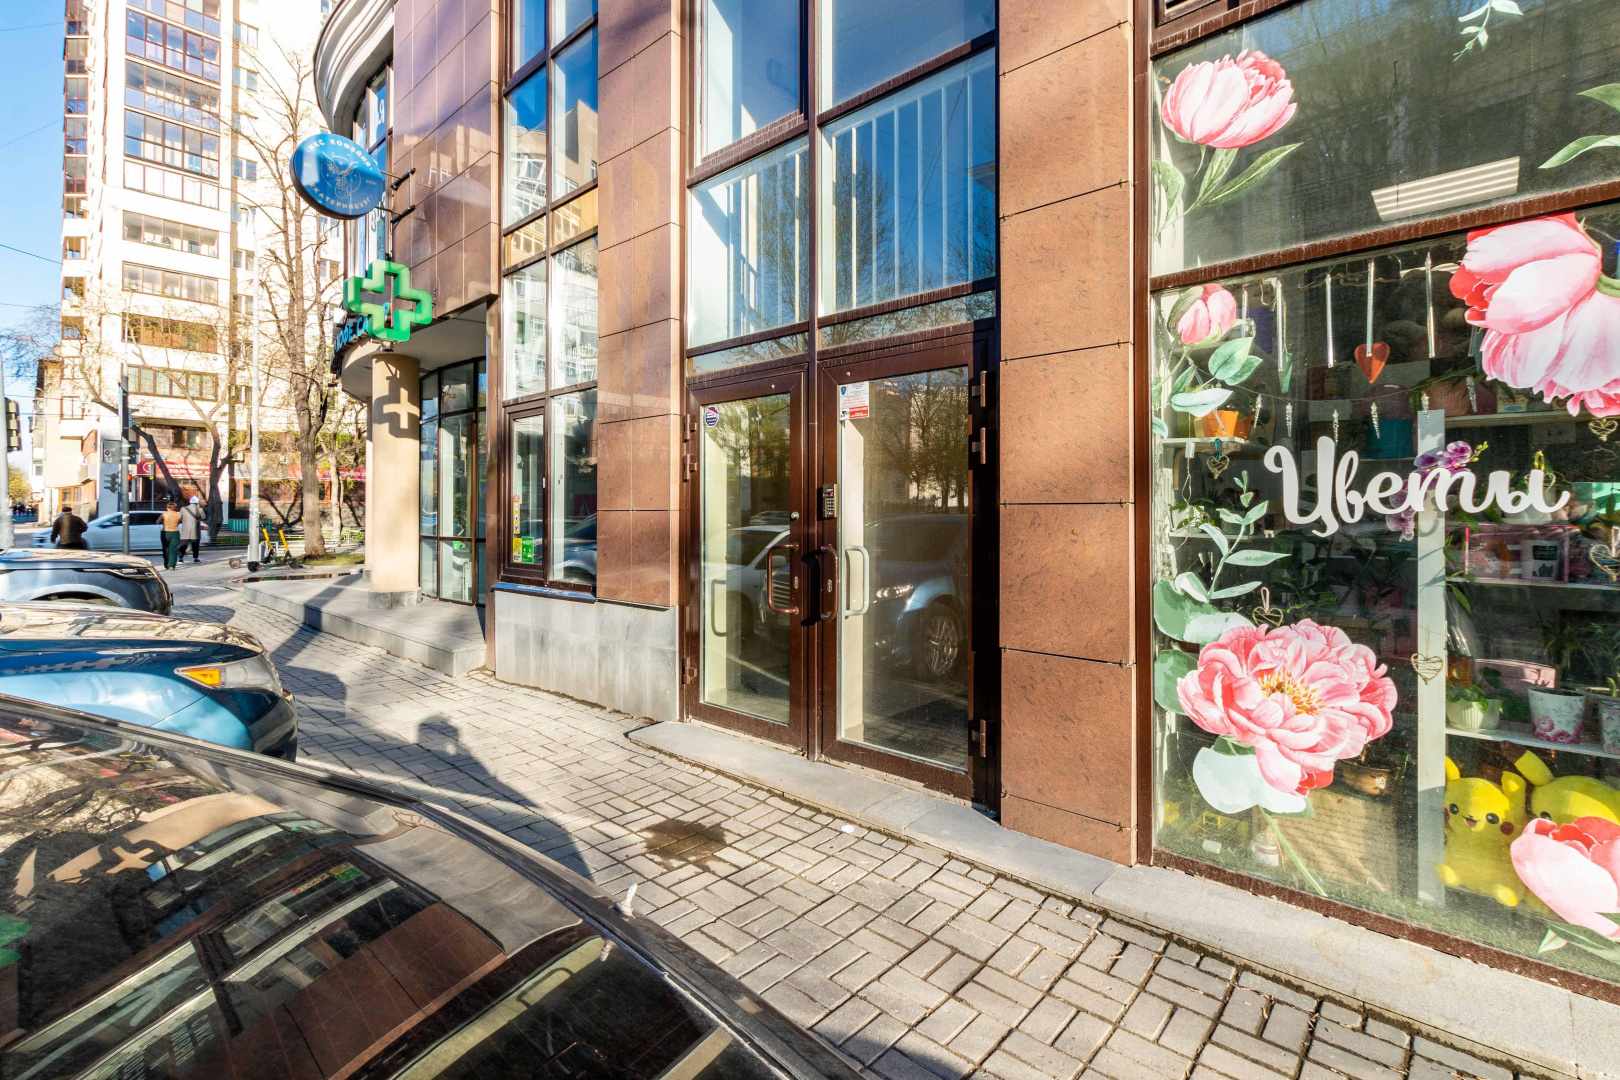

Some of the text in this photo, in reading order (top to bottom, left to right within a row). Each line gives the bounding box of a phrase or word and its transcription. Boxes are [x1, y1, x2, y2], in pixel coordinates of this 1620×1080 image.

[329, 138, 371, 167] КОФЕЙНЯ
[309, 182, 371, 210] ЕКАТЕРИНБУРГ
[1263, 435, 1571, 538] Цветы
